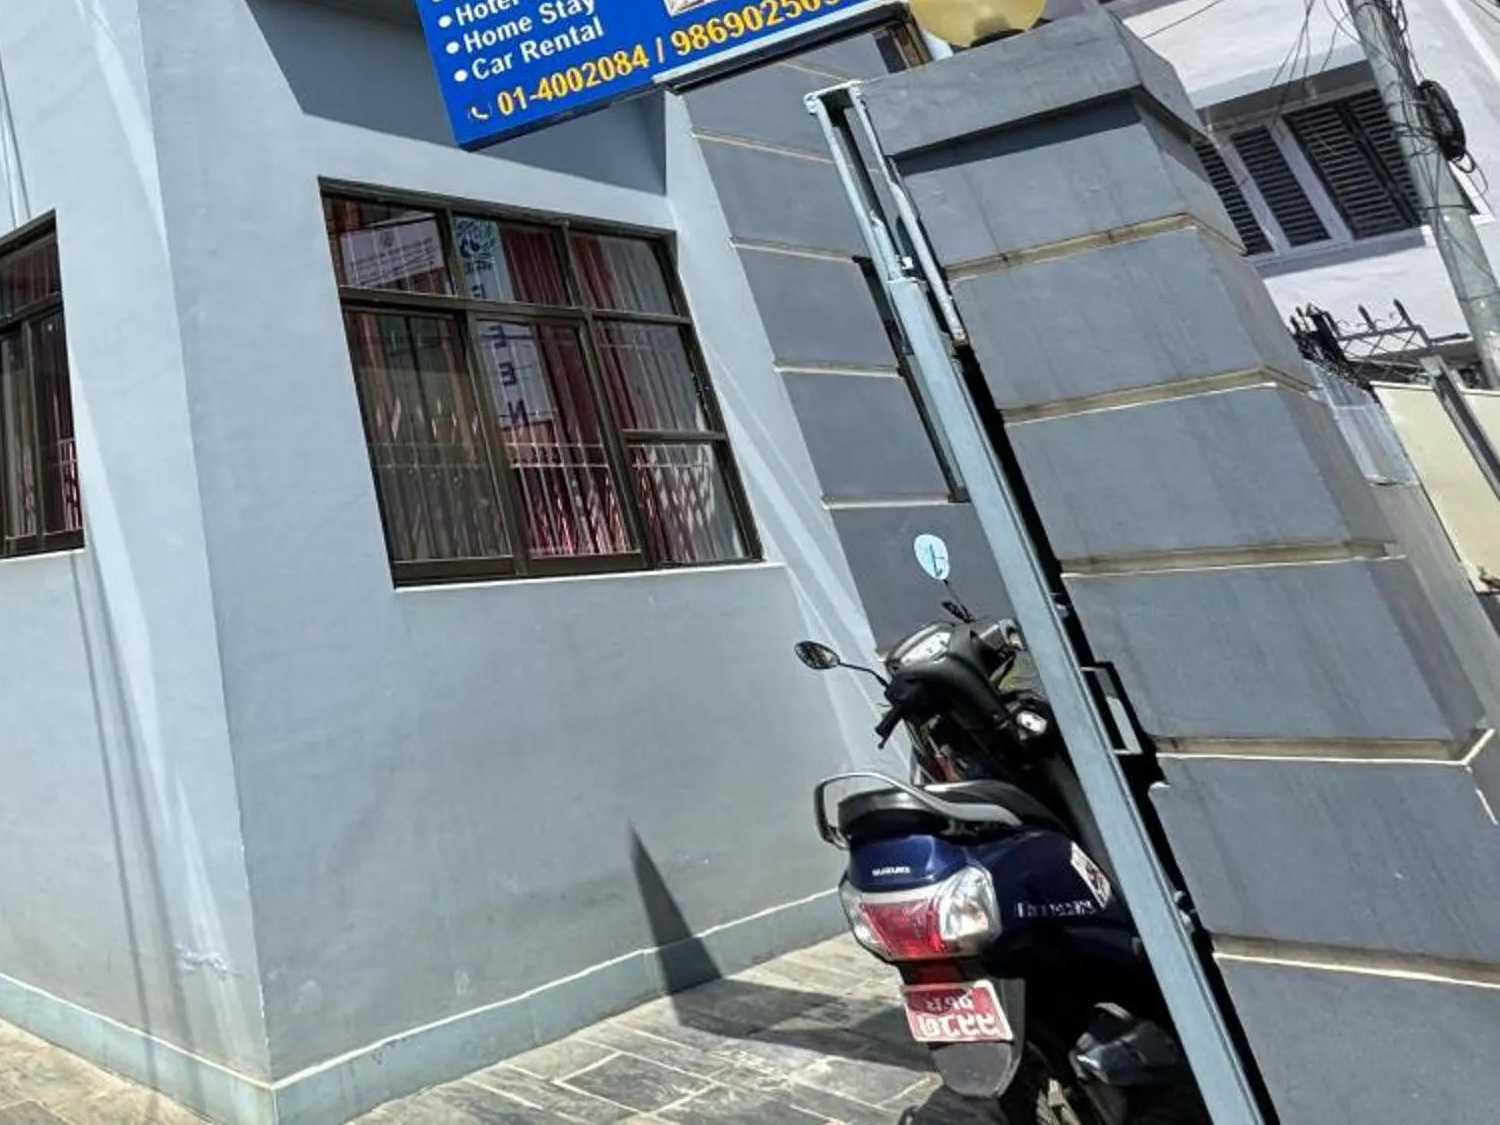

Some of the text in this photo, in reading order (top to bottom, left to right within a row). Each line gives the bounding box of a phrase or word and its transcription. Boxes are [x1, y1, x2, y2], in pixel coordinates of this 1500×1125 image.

[463, 15, 533, 53] Home
[471, 16, 604, 80] Car Rental
[496, 43, 650, 116] 01-4002084
